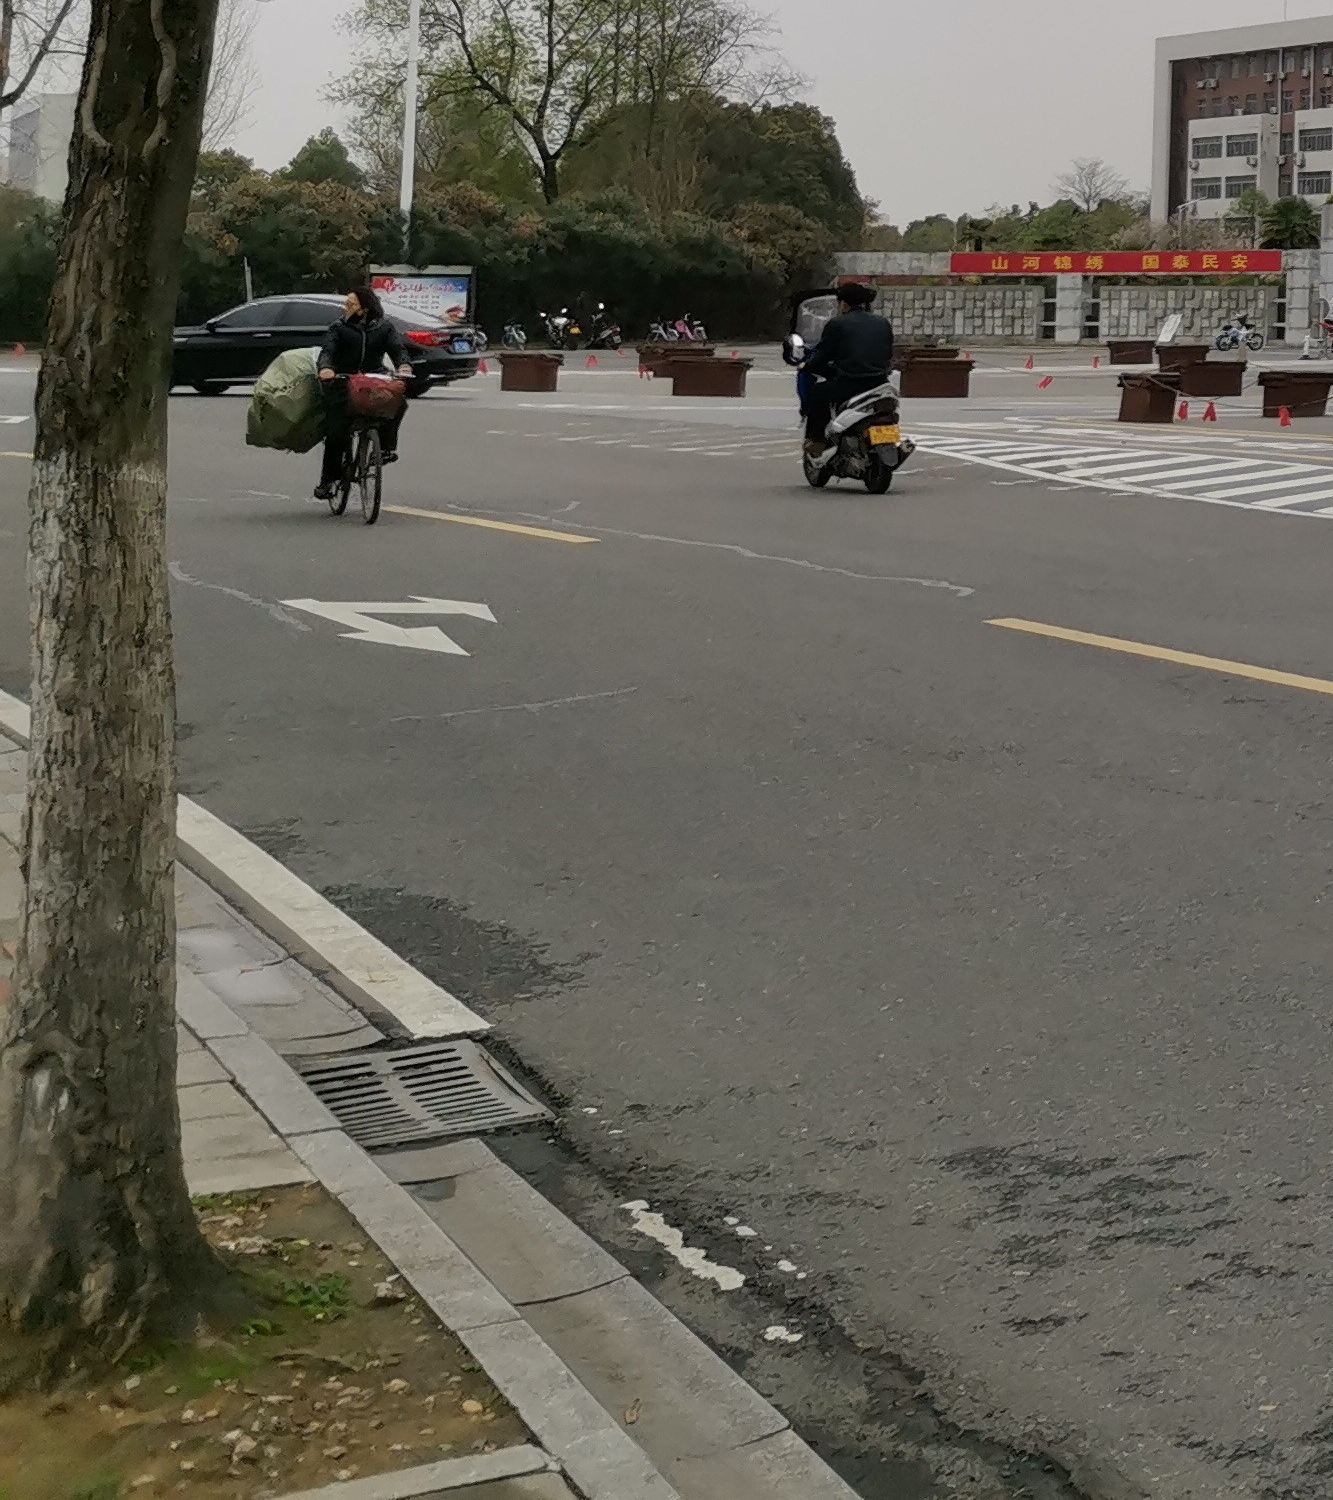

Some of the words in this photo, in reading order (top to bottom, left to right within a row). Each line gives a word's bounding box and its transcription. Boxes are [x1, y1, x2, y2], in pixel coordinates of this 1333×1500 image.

[991, 255, 1105, 270] 山河锦绣
[1142, 255, 1249, 270] 国泰民安
